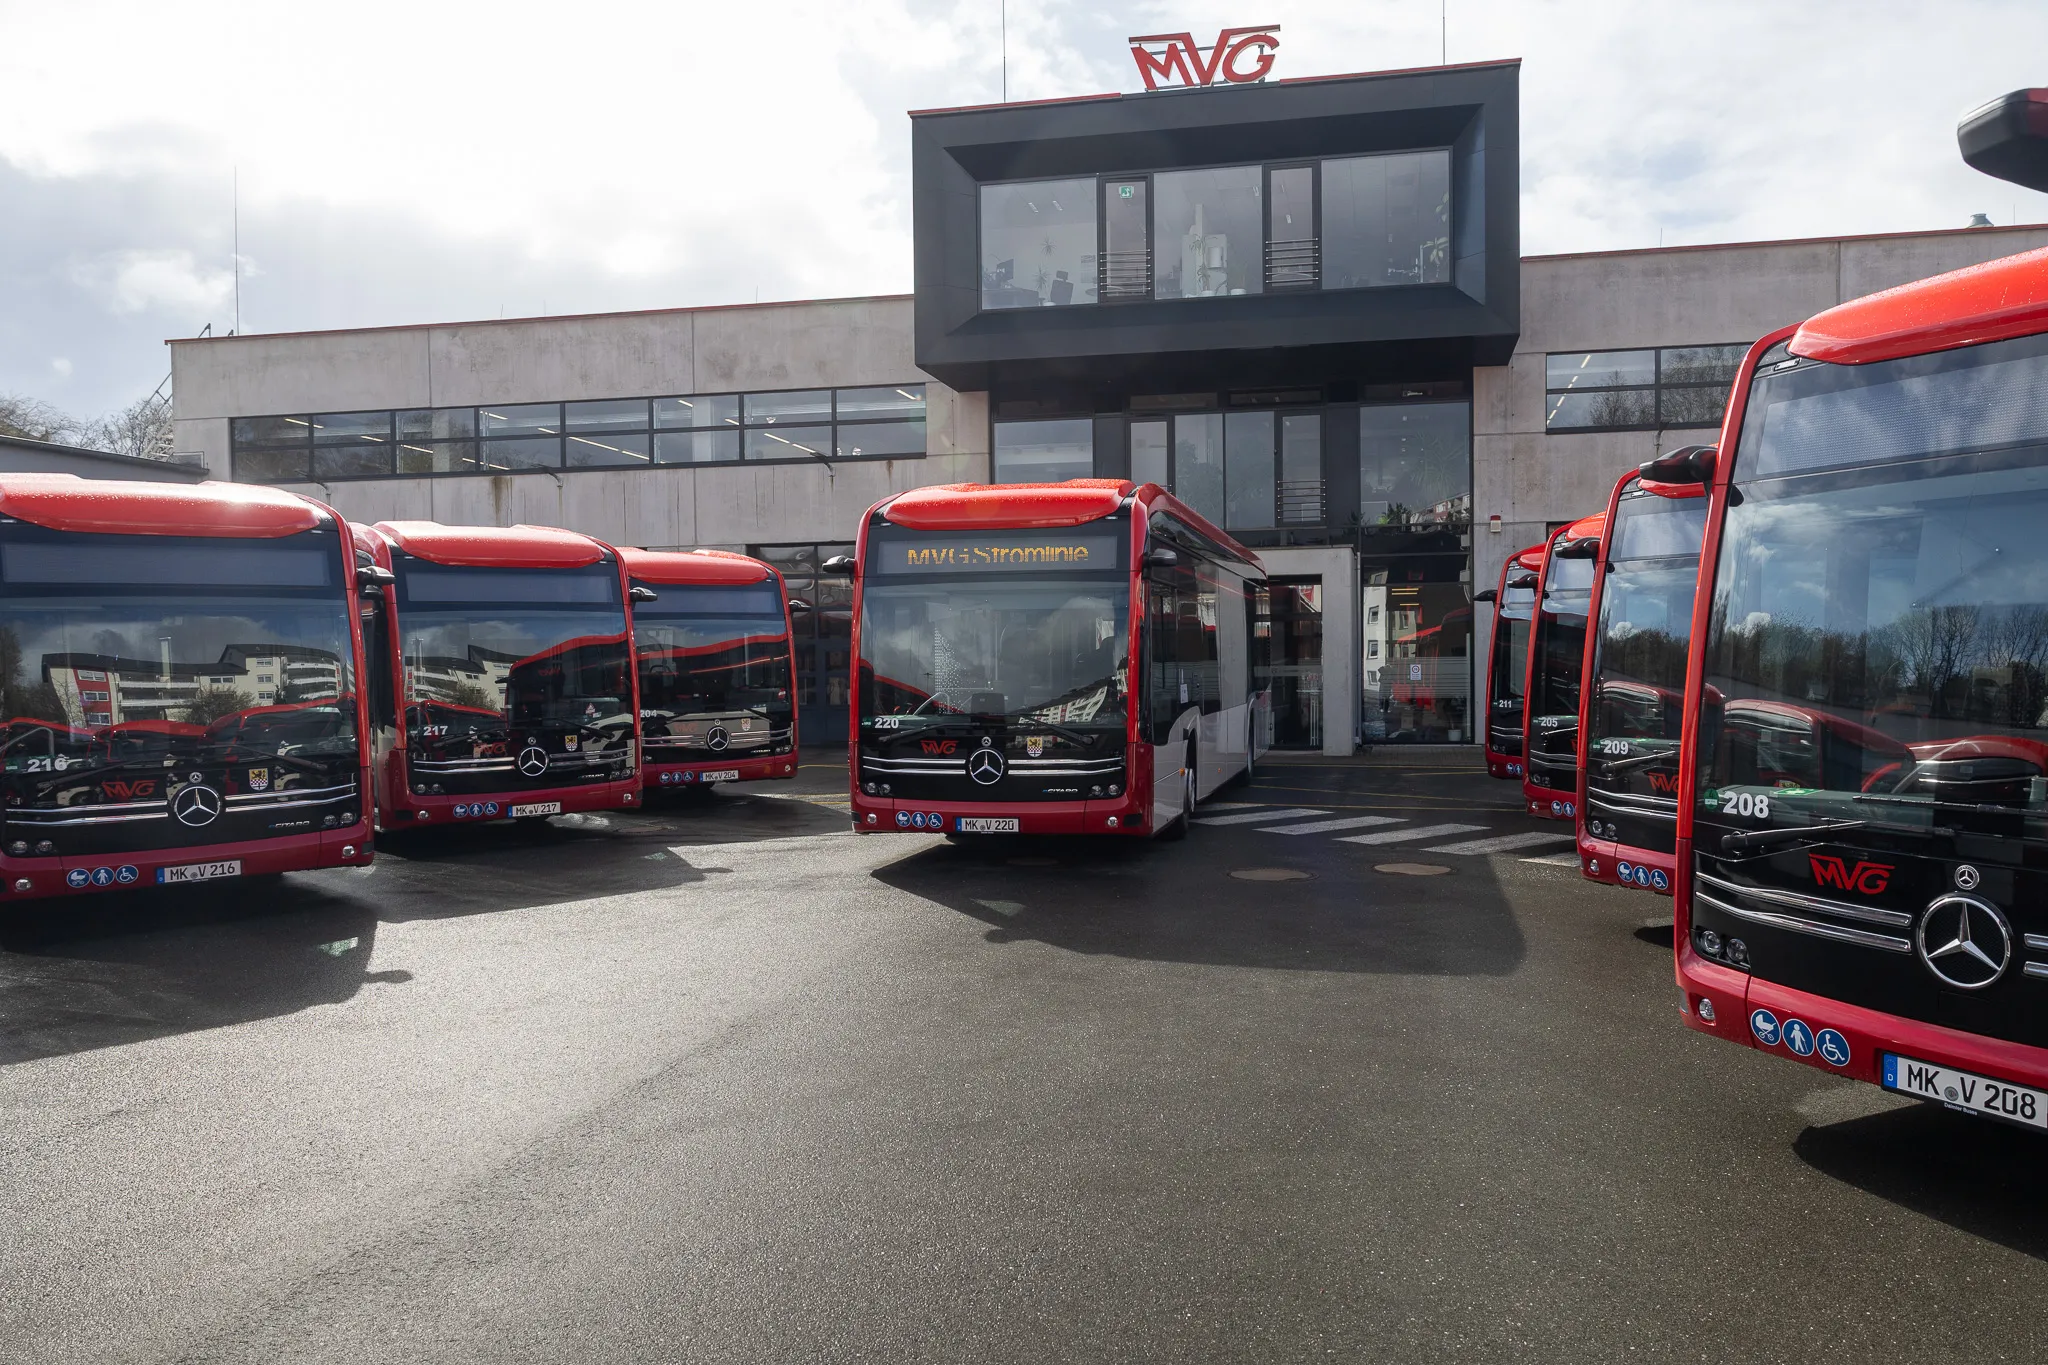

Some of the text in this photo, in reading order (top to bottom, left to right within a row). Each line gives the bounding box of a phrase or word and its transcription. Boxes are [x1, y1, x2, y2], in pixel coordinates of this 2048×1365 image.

[1128, 24, 1281, 92] MVG
[907, 547, 969, 564] MVG
[1499, 699, 1512, 708] 211
[640, 709, 657, 718] 204
[874, 717, 899, 729] 220
[1540, 716, 1558, 727] 205
[423, 725, 448, 736] 217
[920, 740, 959, 755] MVG
[1603, 740, 1629, 755] 209
[27, 757, 68, 773] 216
[101, 780, 157, 799] MVG
[515, 806, 528, 816] MK
[533, 805, 539, 814] V
[540, 804, 557, 813] 217
[1722, 790, 1769, 819] 208
[965, 820, 1014, 830] MK V 220
[170, 862, 236, 881] MK V 216
[1808, 854, 1896, 895] MVG
[1887, 1073, 1894, 1082] D
[1907, 1064, 2037, 1120] MK V 208
